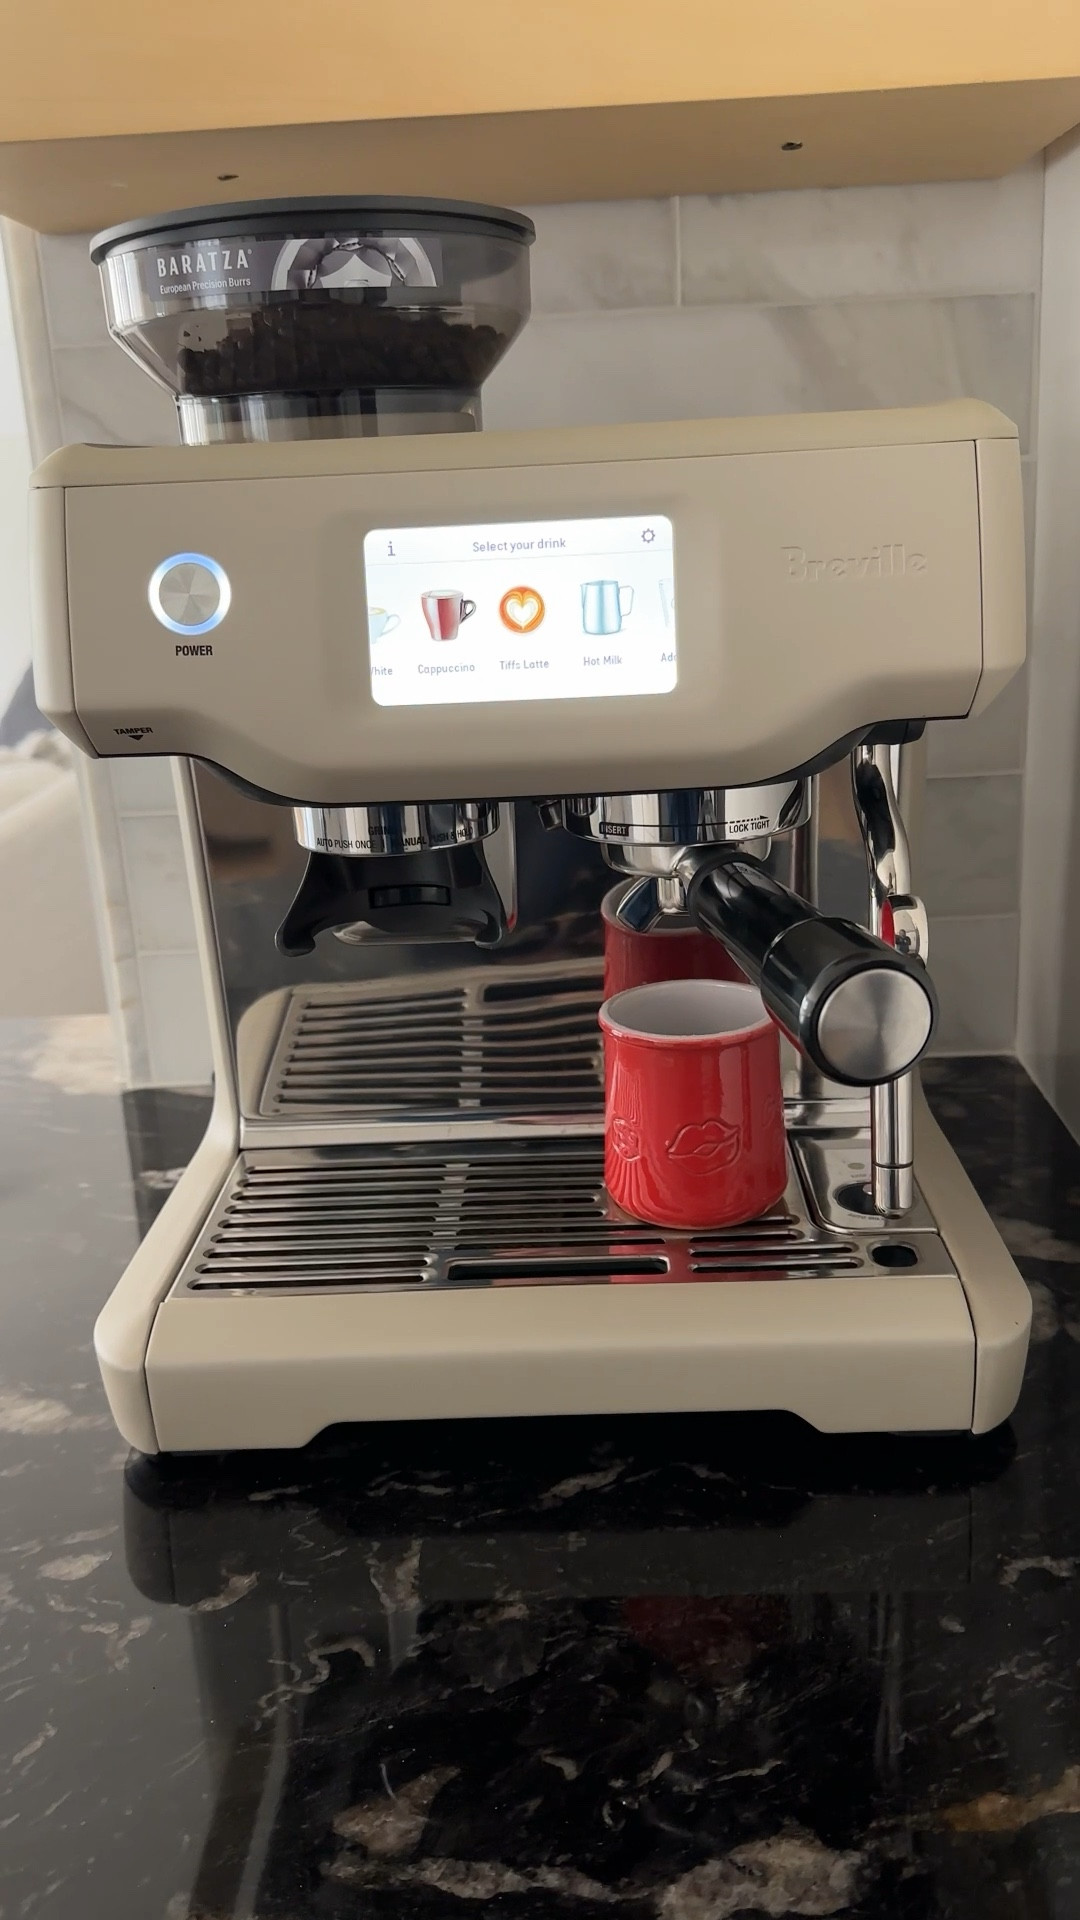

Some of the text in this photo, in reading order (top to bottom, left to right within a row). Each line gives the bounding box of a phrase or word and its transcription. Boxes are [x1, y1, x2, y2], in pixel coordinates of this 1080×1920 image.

[160, 277, 251, 295] European Precision Burrs
[472, 538, 566, 553] Select your drink
[780, 543, 928, 582] Breville
[175, 645, 213, 656] POWER
[523, 659, 550, 669] Latte
[583, 654, 623, 666] Hot Milk
[417, 664, 476, 676] Cappuccino
[113, 727, 154, 735] TAMPER
[729, 820, 771, 834] LOCK TIGHT
[316, 838, 377, 849] AUTO PUSH ONCE
